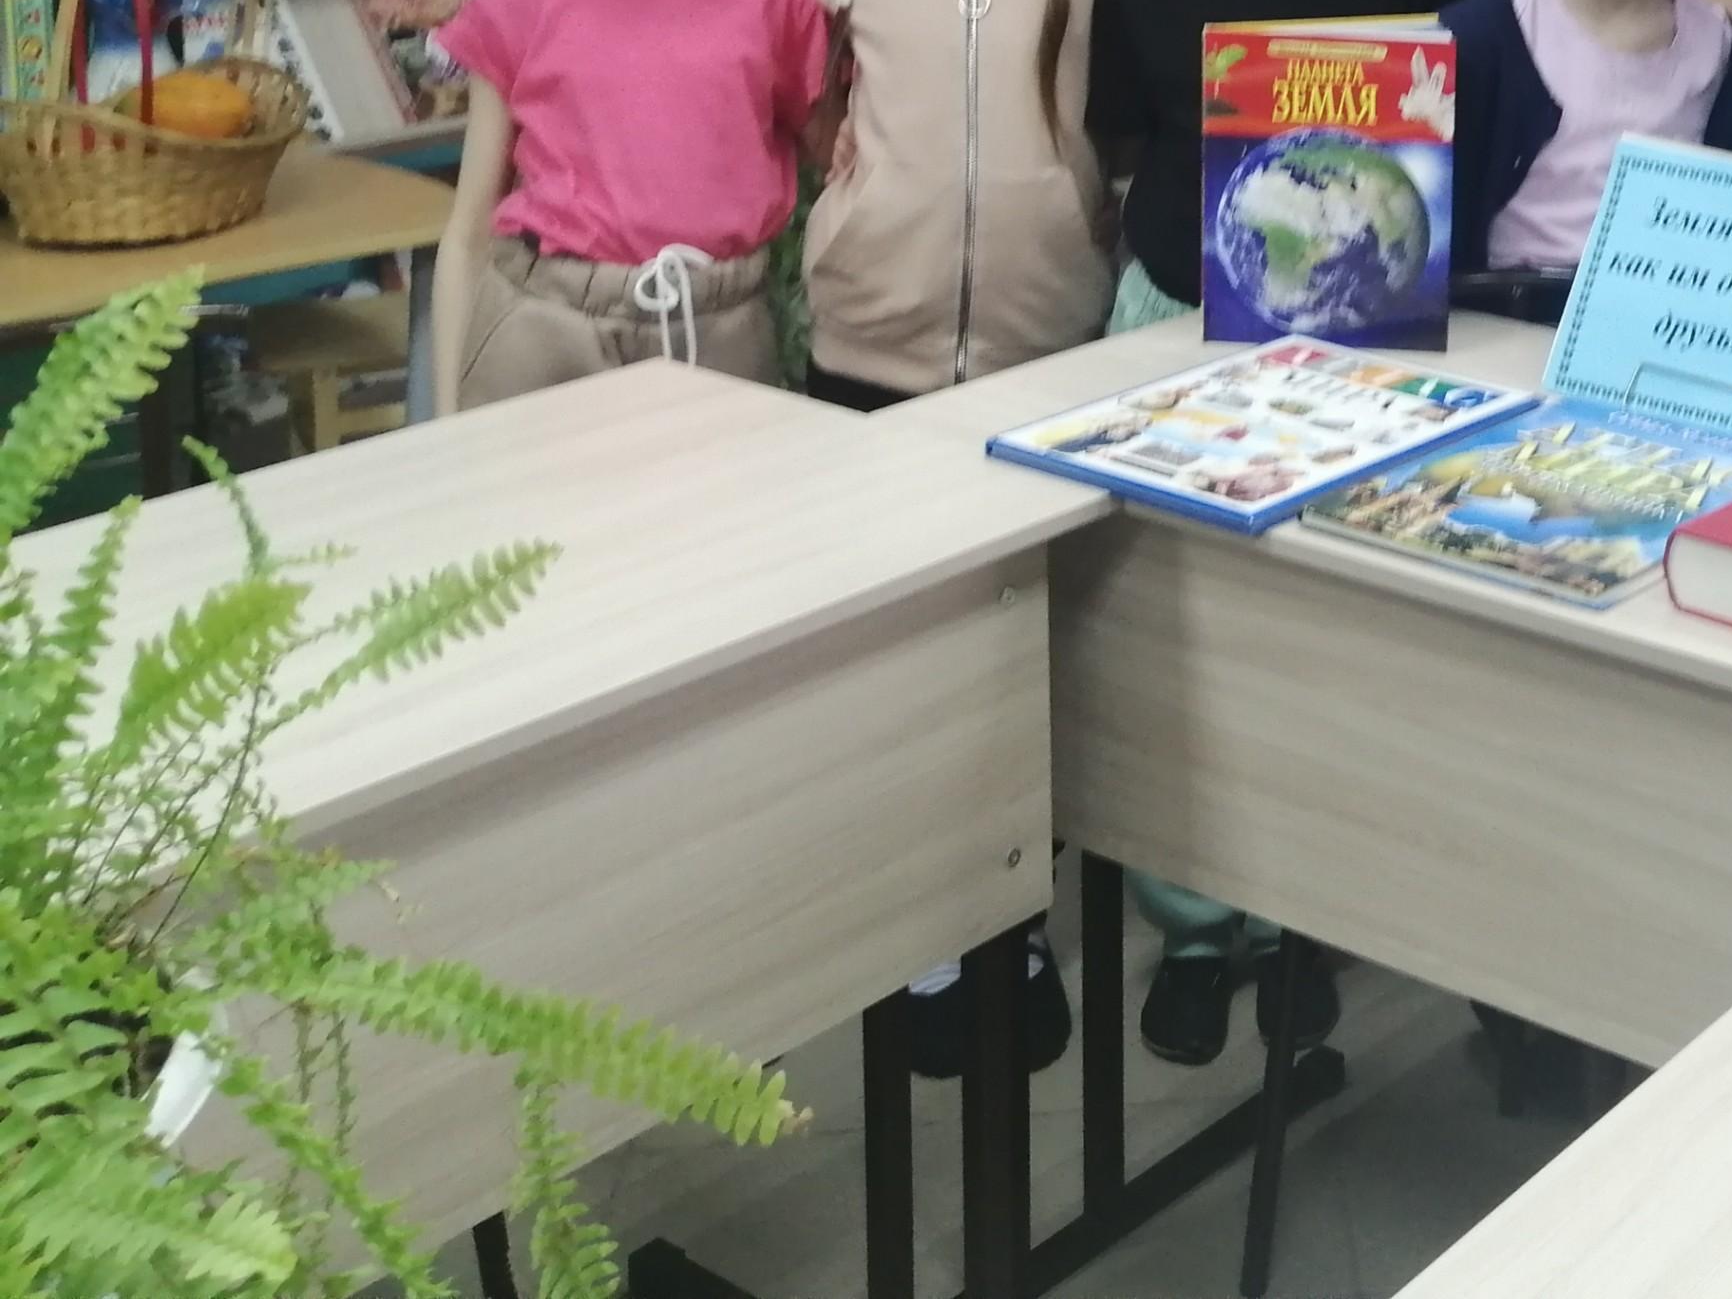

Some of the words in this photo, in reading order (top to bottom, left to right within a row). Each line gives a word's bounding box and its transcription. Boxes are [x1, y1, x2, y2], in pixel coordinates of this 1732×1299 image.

[1272, 77, 1379, 126] ЗЕМЛЯ
[1608, 250, 1663, 280] как
[1667, 261, 1711, 295] им
